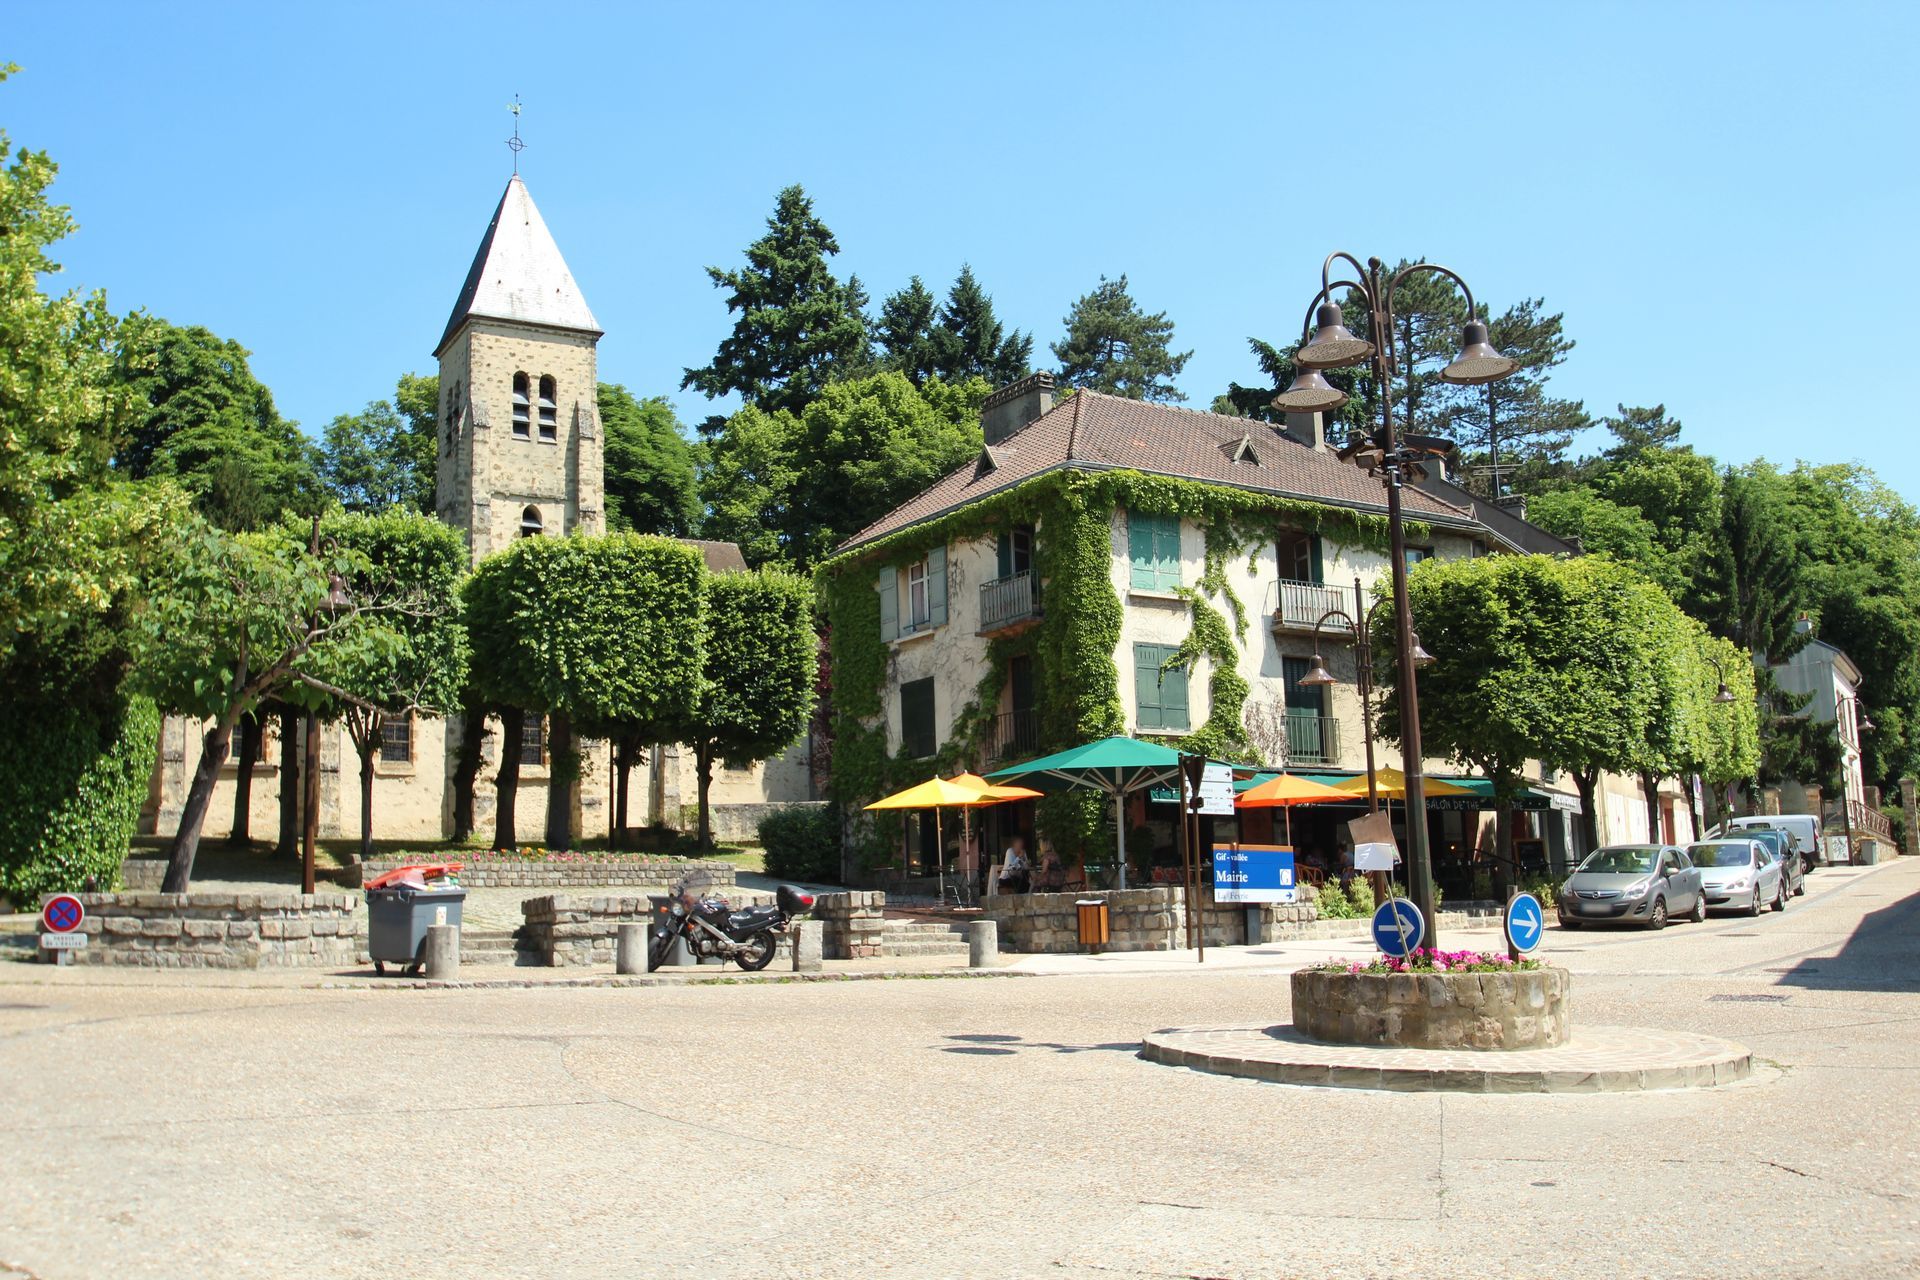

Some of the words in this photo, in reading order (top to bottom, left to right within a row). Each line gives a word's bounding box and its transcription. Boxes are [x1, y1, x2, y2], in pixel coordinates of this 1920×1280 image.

[1426, 800, 1451, 809] SALON
[1453, 800, 1464, 810] DE
[1215, 852, 1227, 861] Gif
[1230, 853, 1249, 862] vallée
[1215, 870, 1249, 883] Mairie
